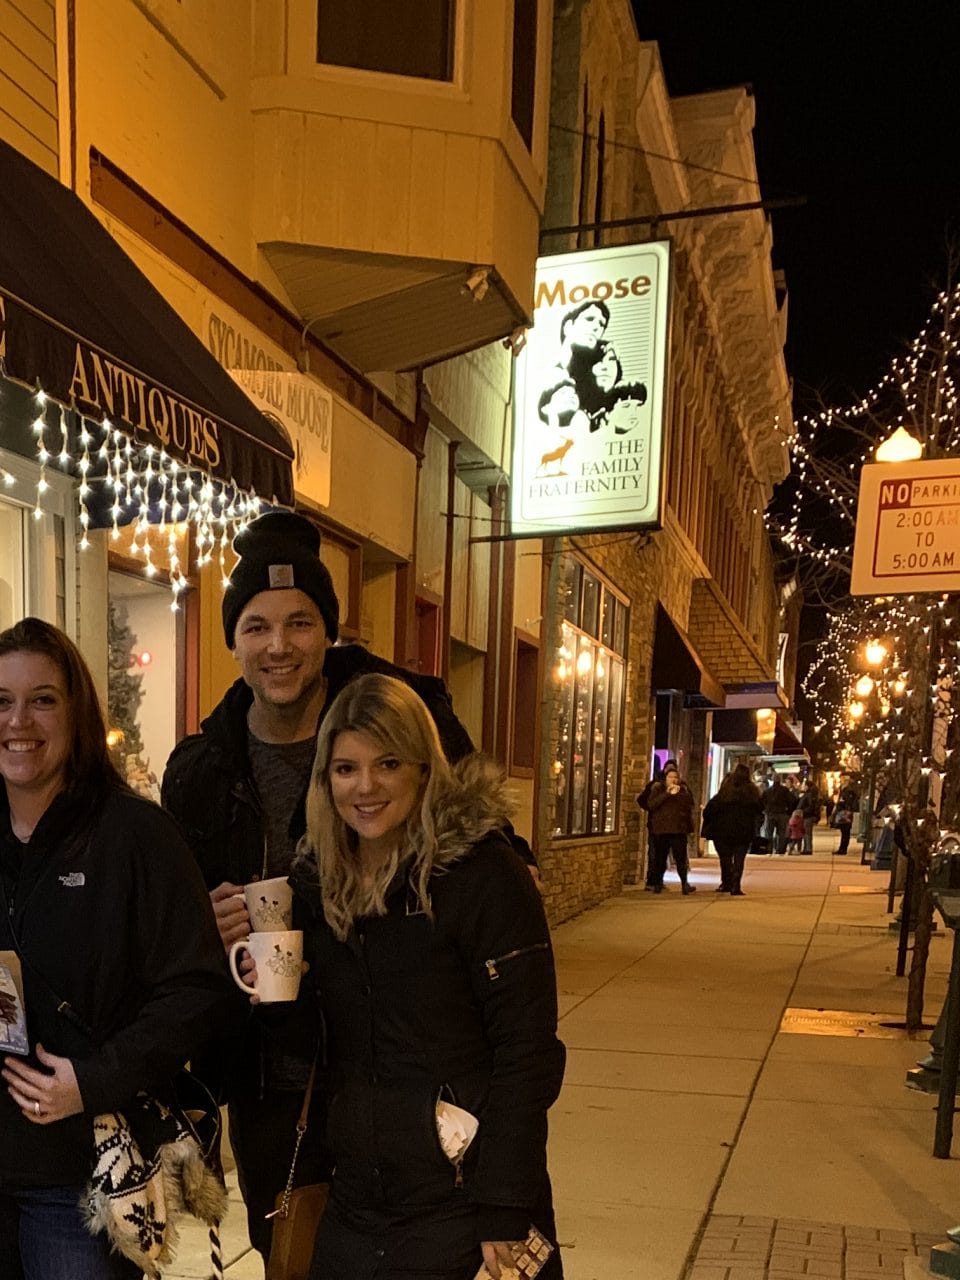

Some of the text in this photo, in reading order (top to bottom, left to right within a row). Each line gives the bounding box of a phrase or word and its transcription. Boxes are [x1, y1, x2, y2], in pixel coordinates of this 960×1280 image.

[534, 274, 652, 309] Moose
[208, 311, 330, 454] SYCAMORE MOOSE
[69, 342, 221, 467] ANTIQUES
[605, 438, 645, 456] THE
[581, 456, 644, 476] FAMILY
[528, 474, 643, 499] FRATERNITY
[881, 483, 960, 505] NO PARKI
[896, 510, 933, 528] 2:00
[915, 531, 935, 548] TO
[893, 551, 955, 569] 5:00 AM
